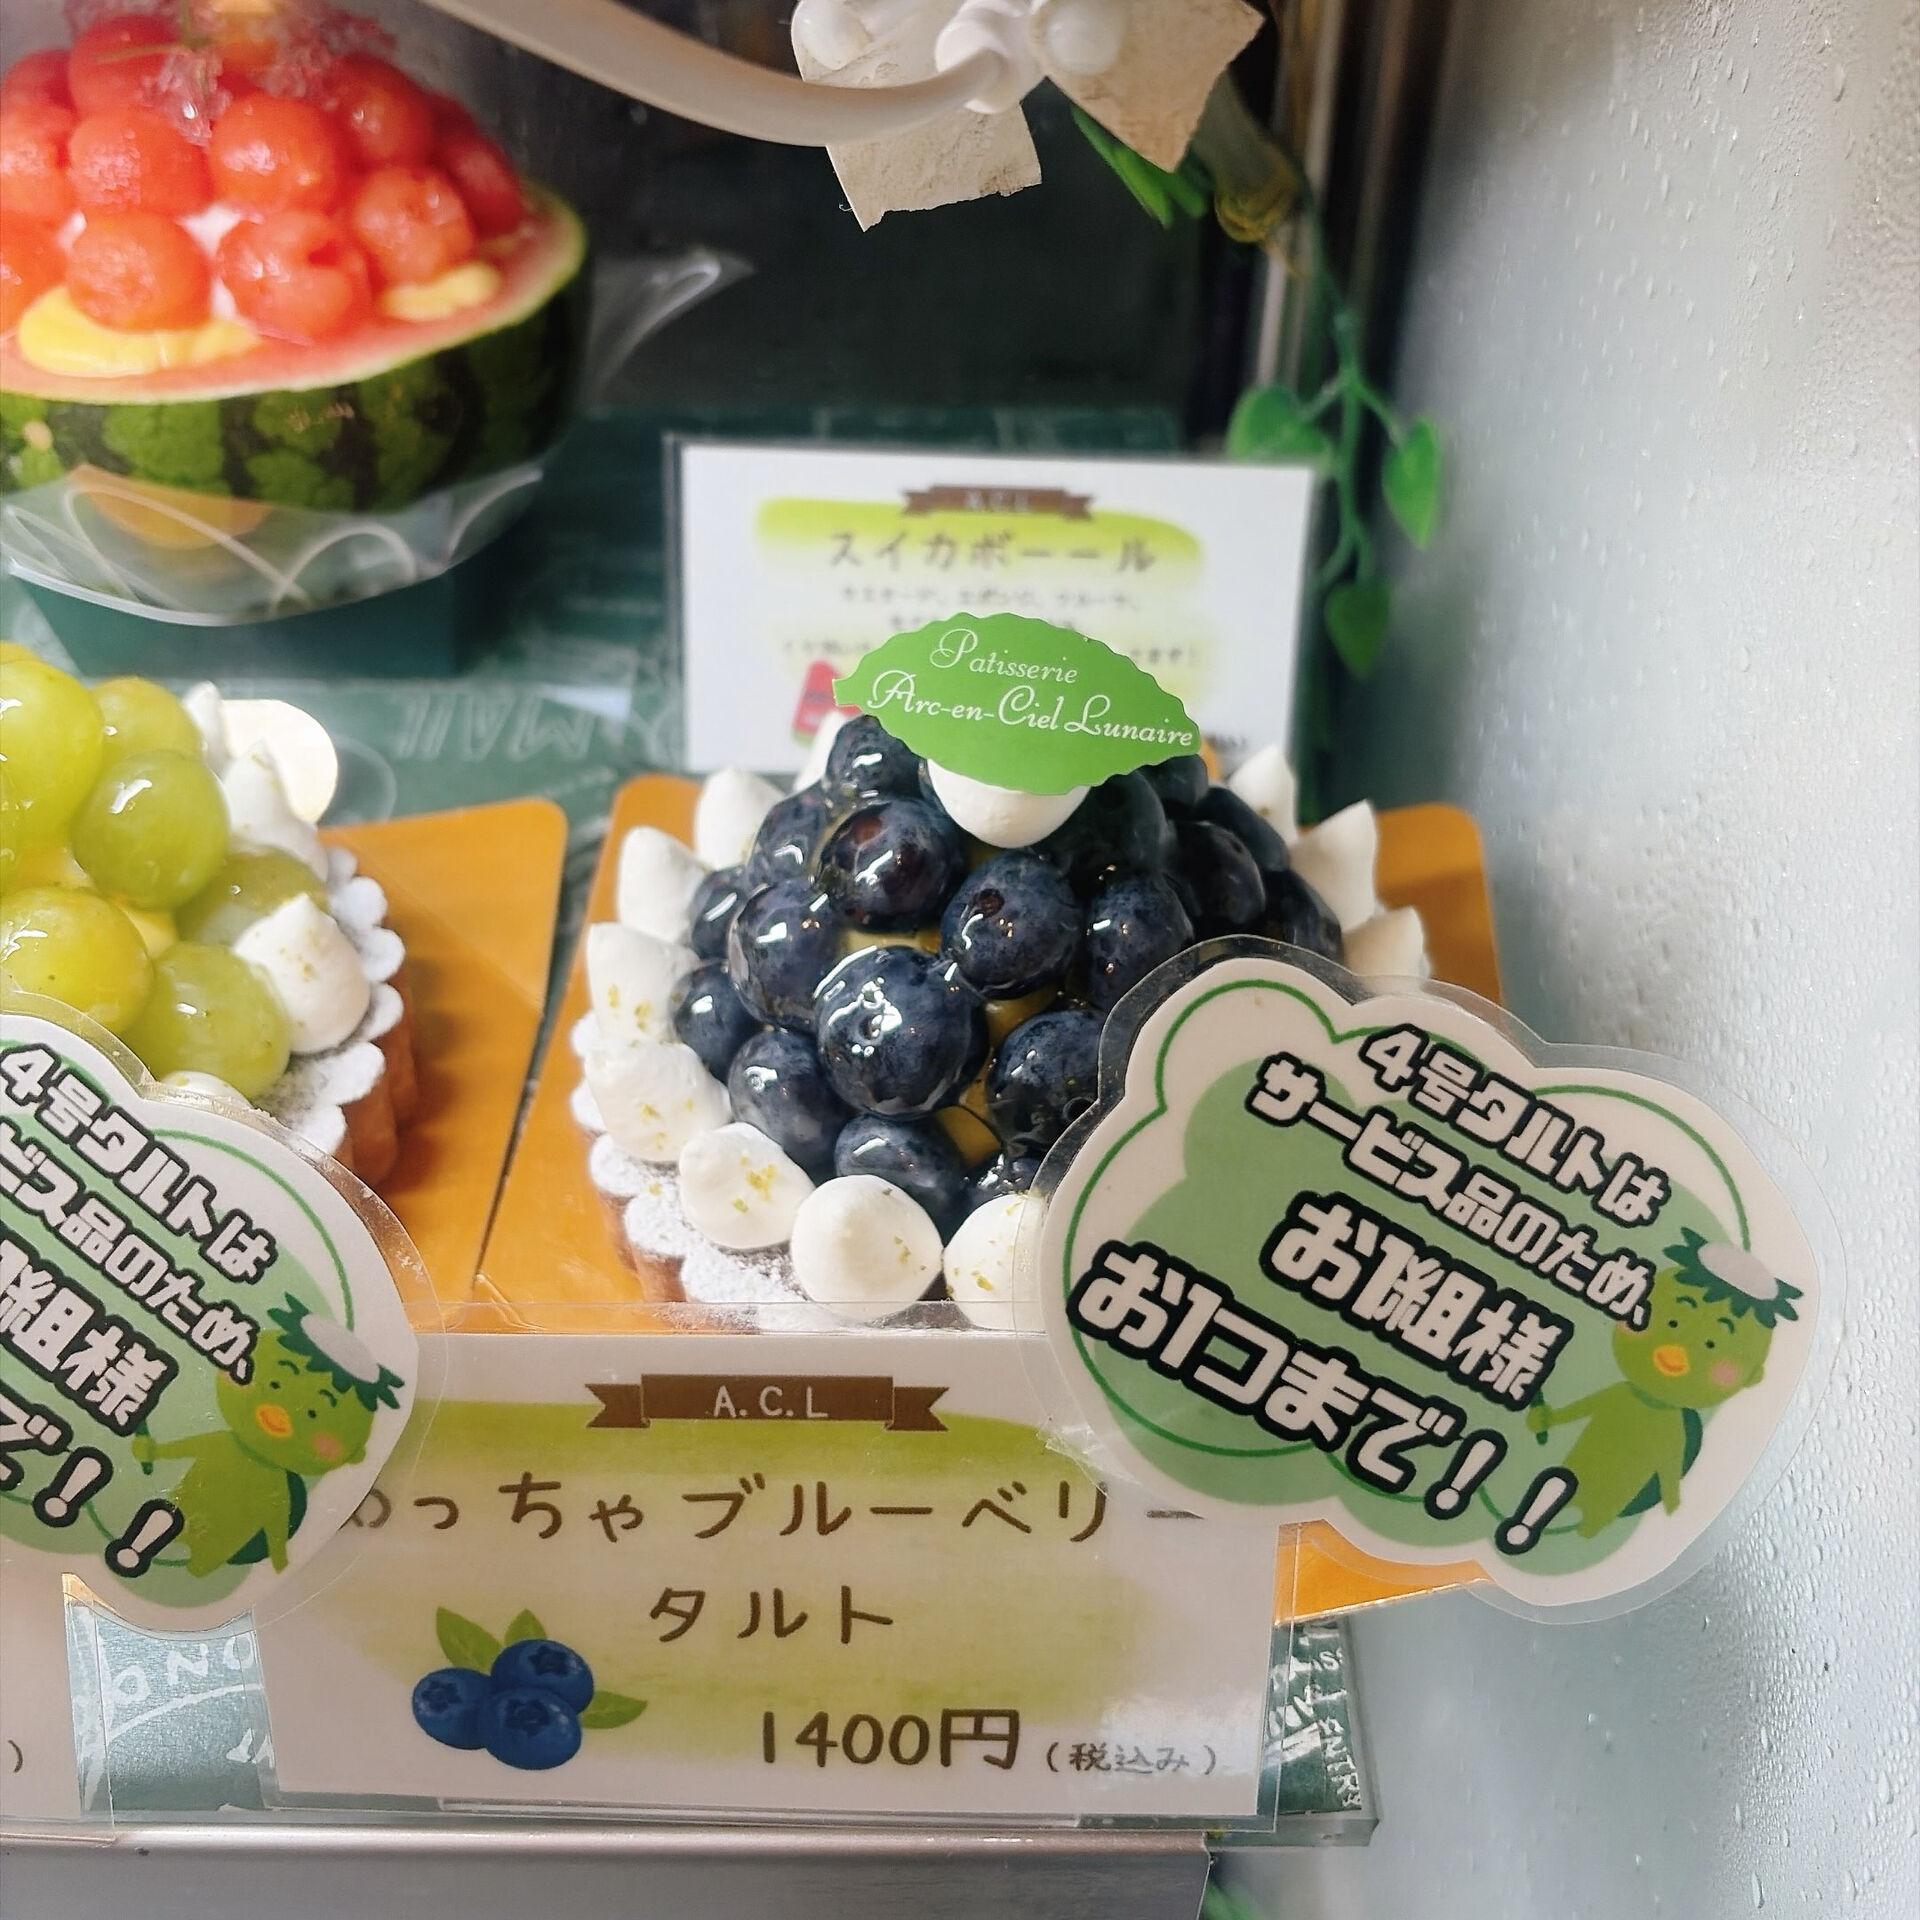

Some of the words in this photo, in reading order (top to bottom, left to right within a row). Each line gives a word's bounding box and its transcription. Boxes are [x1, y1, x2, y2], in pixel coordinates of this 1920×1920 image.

[830, 530, 1157, 573] スイカボーール
[930, 628, 1078, 684] Patisserie
[867, 669, 1064, 731] Arc-en-Ciel
[1064, 694, 1193, 747] Lunaire
[0, 1044, 277, 1283] 4号タルトは
[1360, 1024, 1670, 1227] 4号タルトは
[1246, 1052, 1656, 1332] サービス品のため、
[1262, 1193, 1573, 1409] お1組様
[713, 1385, 828, 1419] A.C.L
[1068, 1241, 1577, 1554] お1コまで！！
[649, 1583, 893, 1645] タルト
[763, 1708, 1020, 1770] 1400円
[1045, 1742, 1217, 1776] （税込み）
